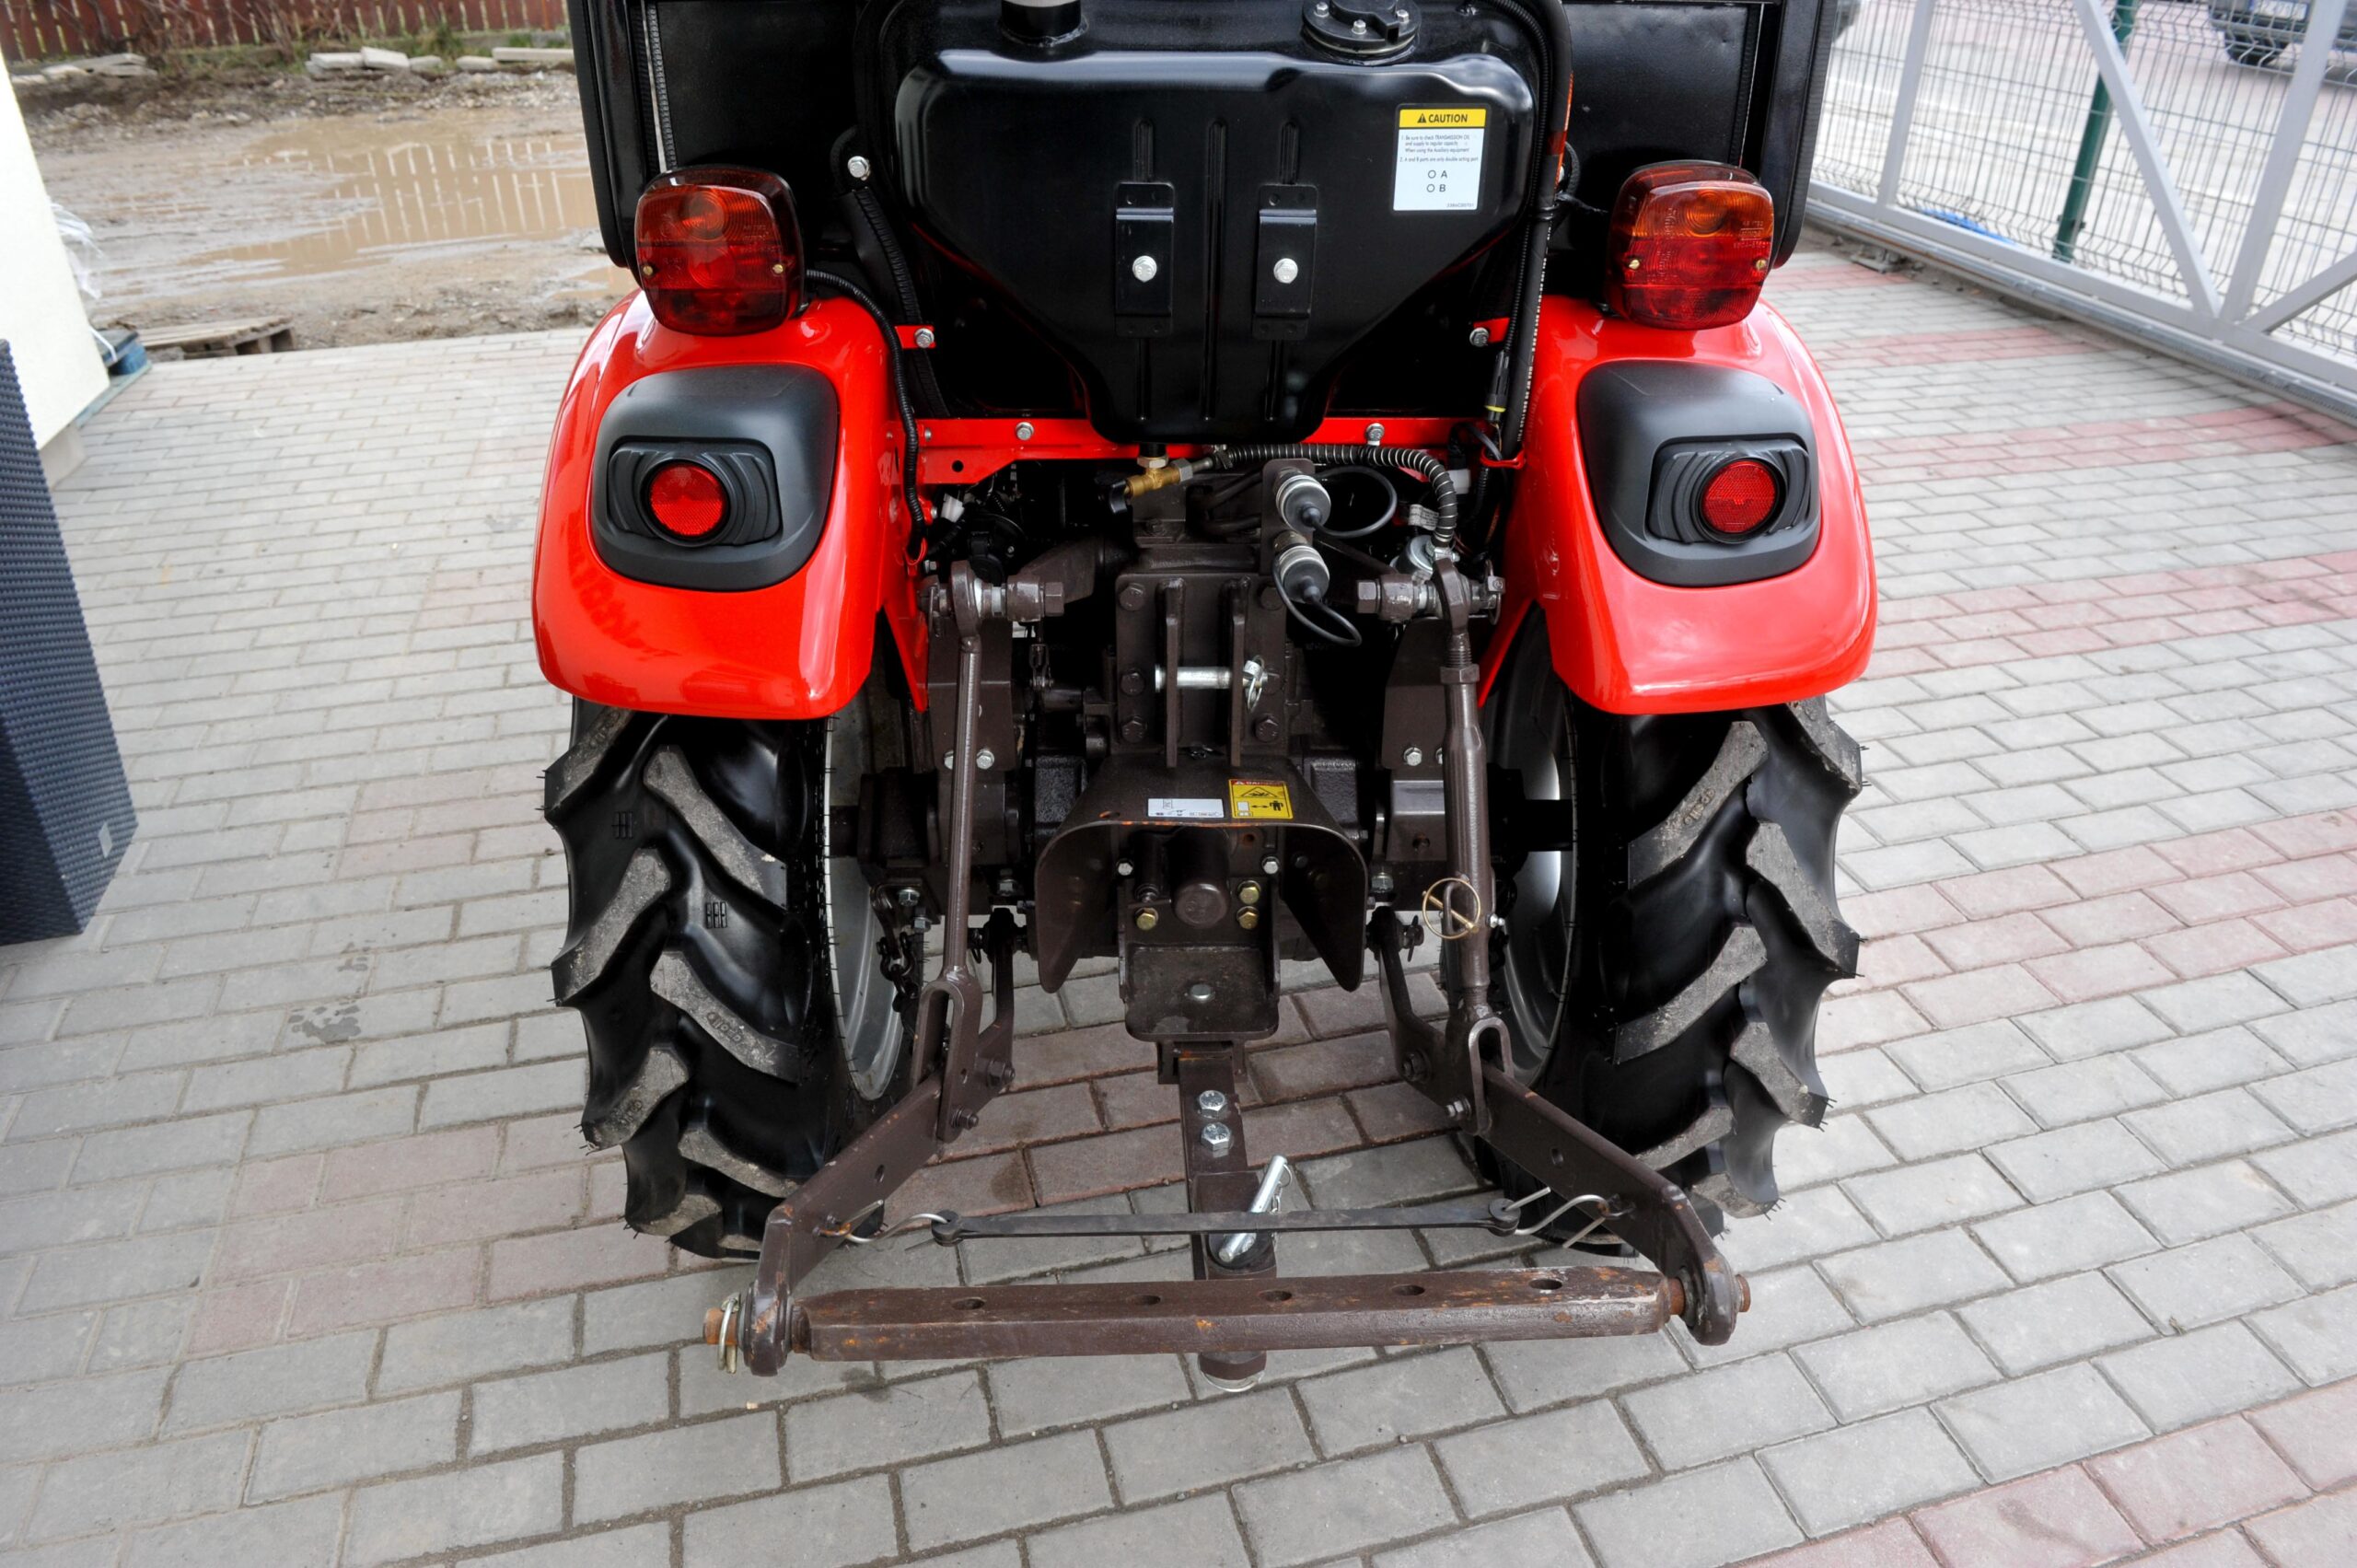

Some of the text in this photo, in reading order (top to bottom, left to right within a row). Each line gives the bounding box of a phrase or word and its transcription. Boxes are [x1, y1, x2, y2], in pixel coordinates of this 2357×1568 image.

[1428, 113, 1468, 123] CAUTION
[1441, 169, 1448, 179] A
[1439, 183, 1446, 192] B
